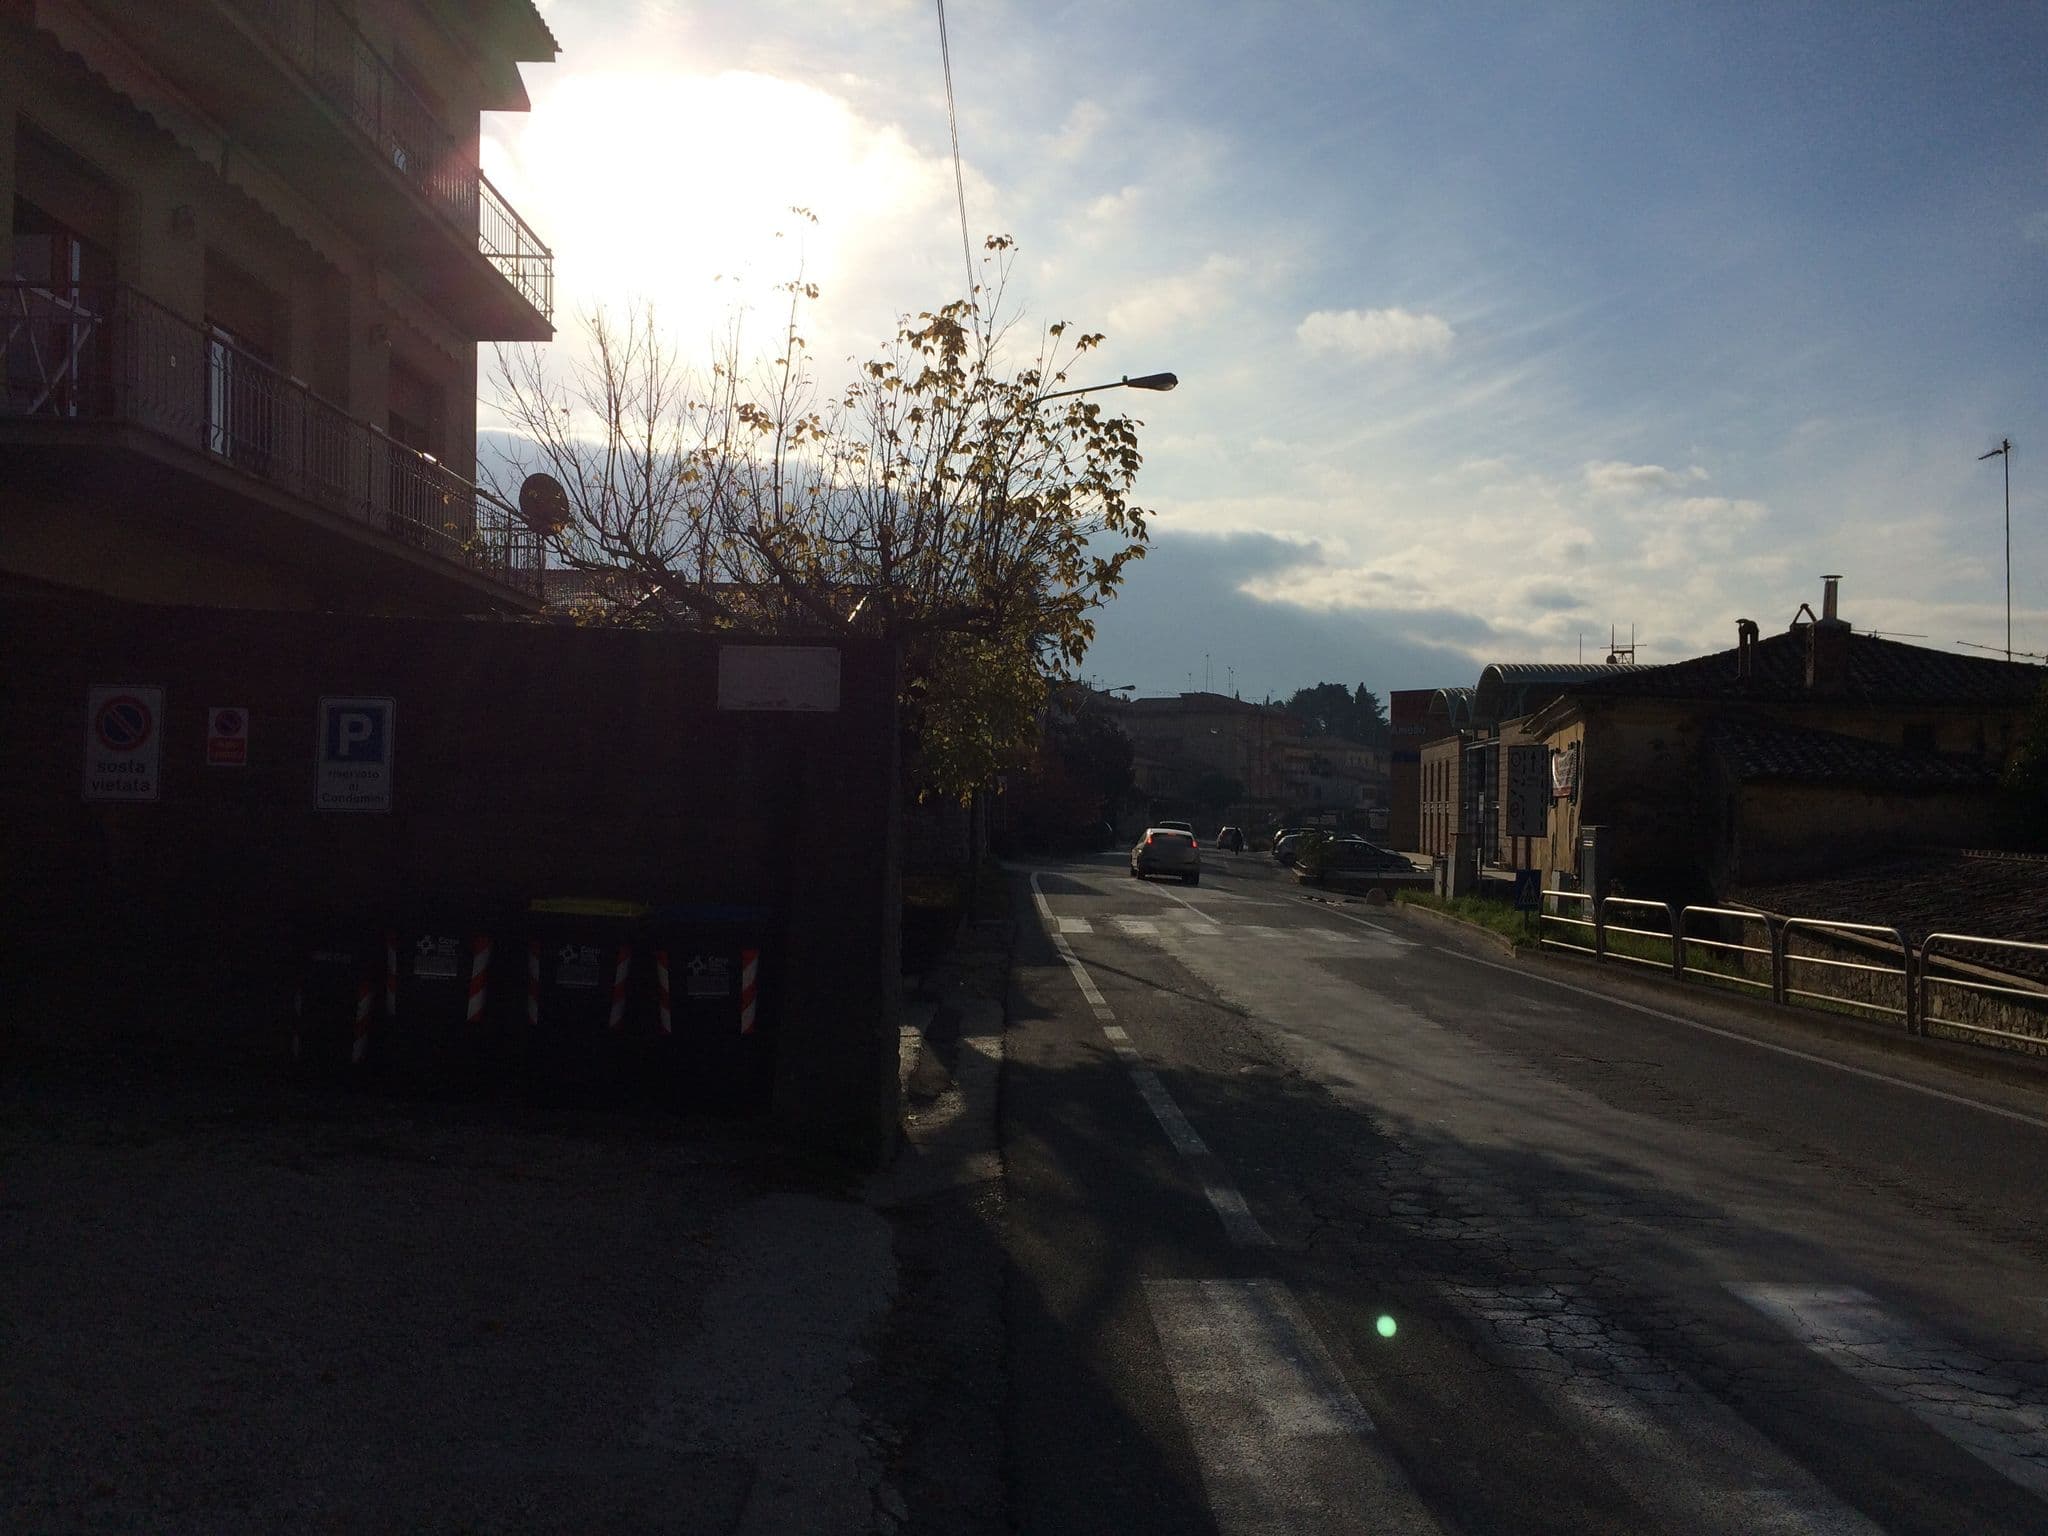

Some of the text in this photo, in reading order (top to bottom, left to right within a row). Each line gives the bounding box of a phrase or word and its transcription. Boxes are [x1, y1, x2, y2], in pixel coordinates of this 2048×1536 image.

[339, 712, 374, 753] P
[97, 759, 145, 773] sosta
[91, 778, 151, 793] vietata
